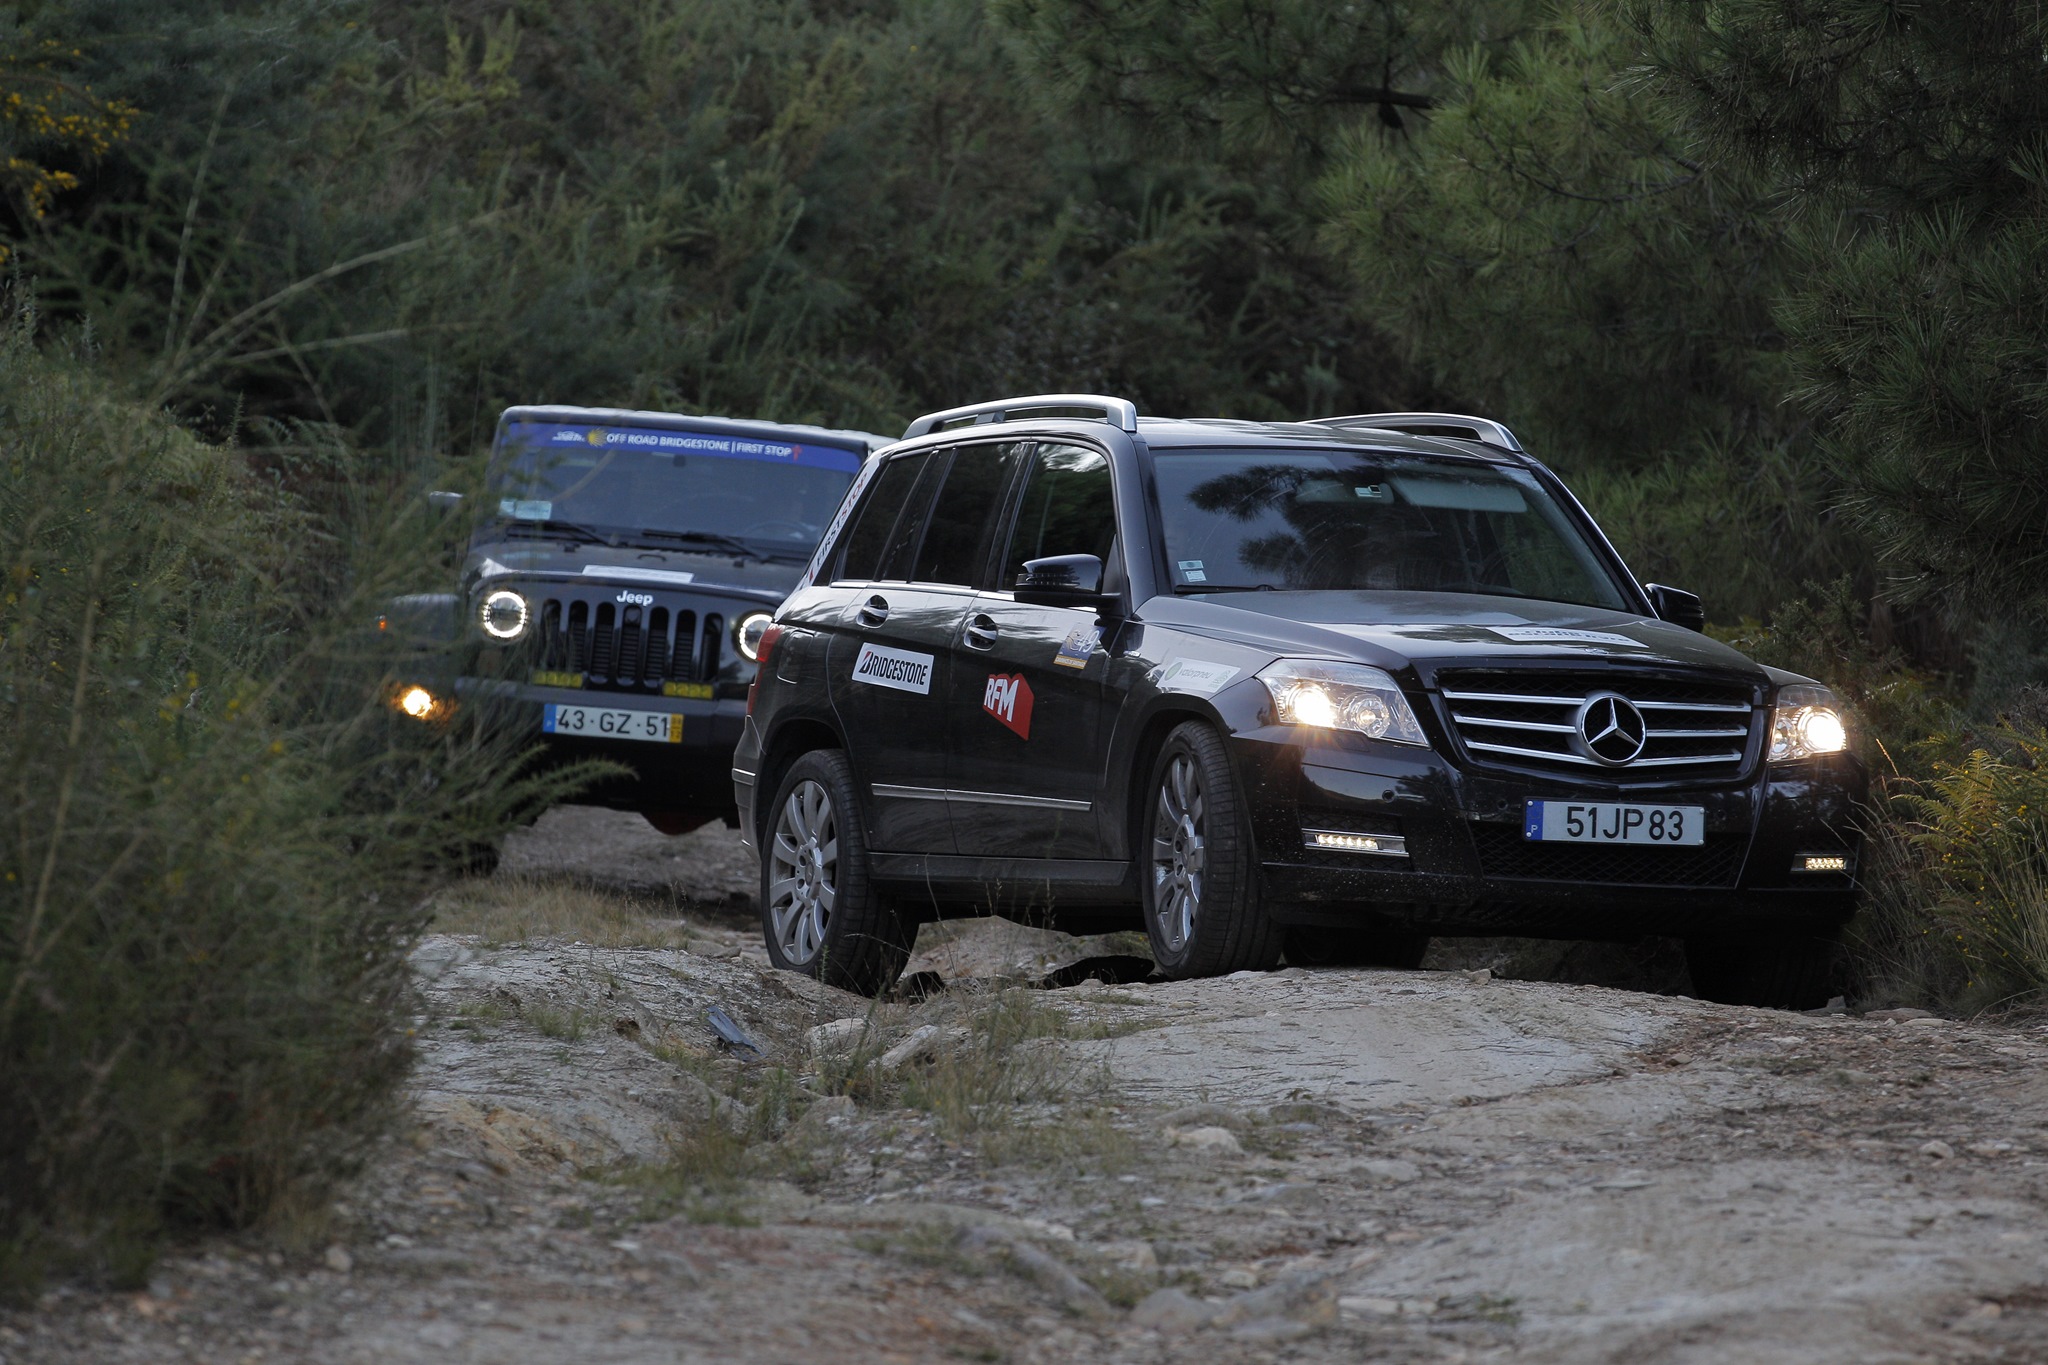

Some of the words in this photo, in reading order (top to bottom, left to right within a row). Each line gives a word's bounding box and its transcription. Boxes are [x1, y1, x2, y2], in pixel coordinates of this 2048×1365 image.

[606, 432, 627, 444] OFF
[627, 434, 658, 446] ROAD
[659, 436, 730, 452] BRIDGESTONE
[736, 442, 764, 455] FIRST
[764, 445, 793, 458] STOP
[616, 590, 654, 607] Jeep
[858, 651, 929, 686] BRIDGESTONE
[983, 677, 1020, 722] RFM
[1530, 824, 1538, 834] P
[1566, 806, 1684, 842] 51JP83
